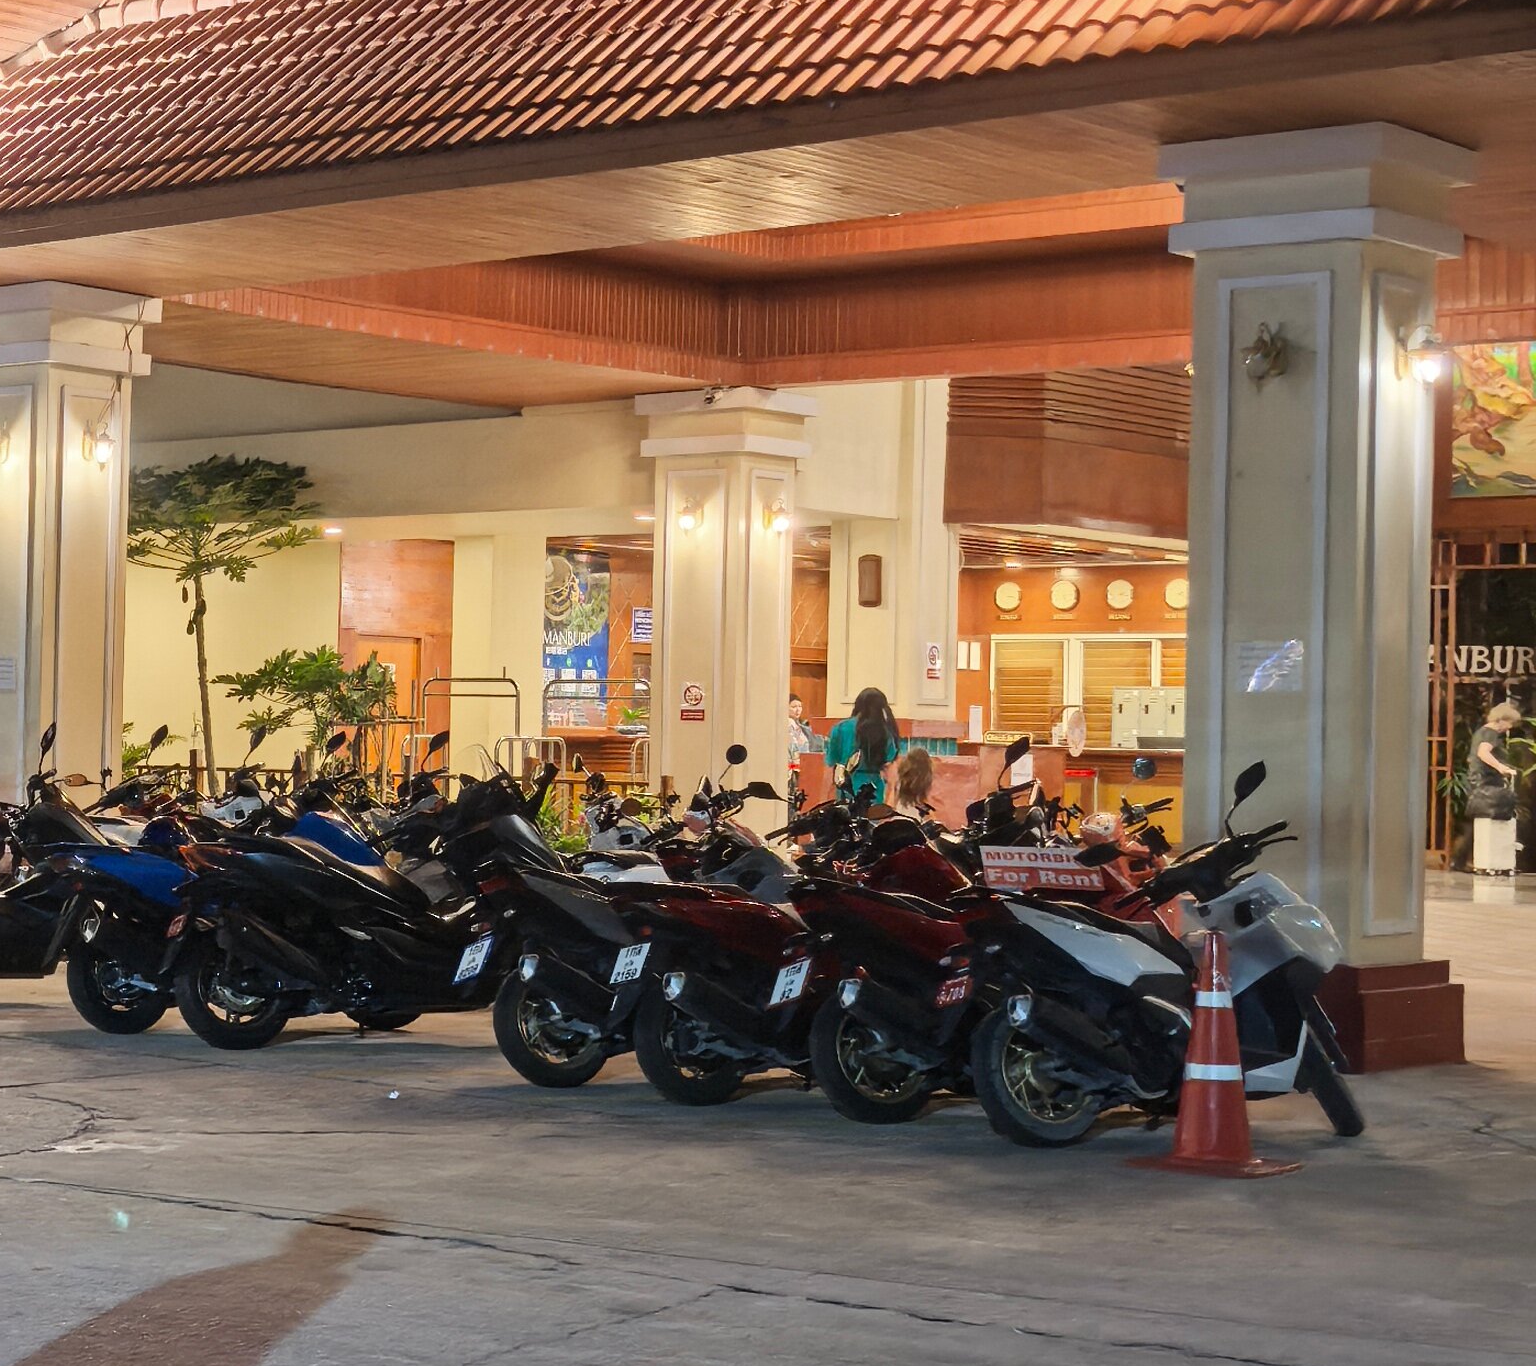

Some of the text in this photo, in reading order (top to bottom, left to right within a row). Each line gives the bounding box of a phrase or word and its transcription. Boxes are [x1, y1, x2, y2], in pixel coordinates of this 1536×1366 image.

[1427, 644, 1536, 673] NBUR
[986, 851, 1076, 863] MOTORBI
[987, 869, 1102, 887] For Rent
